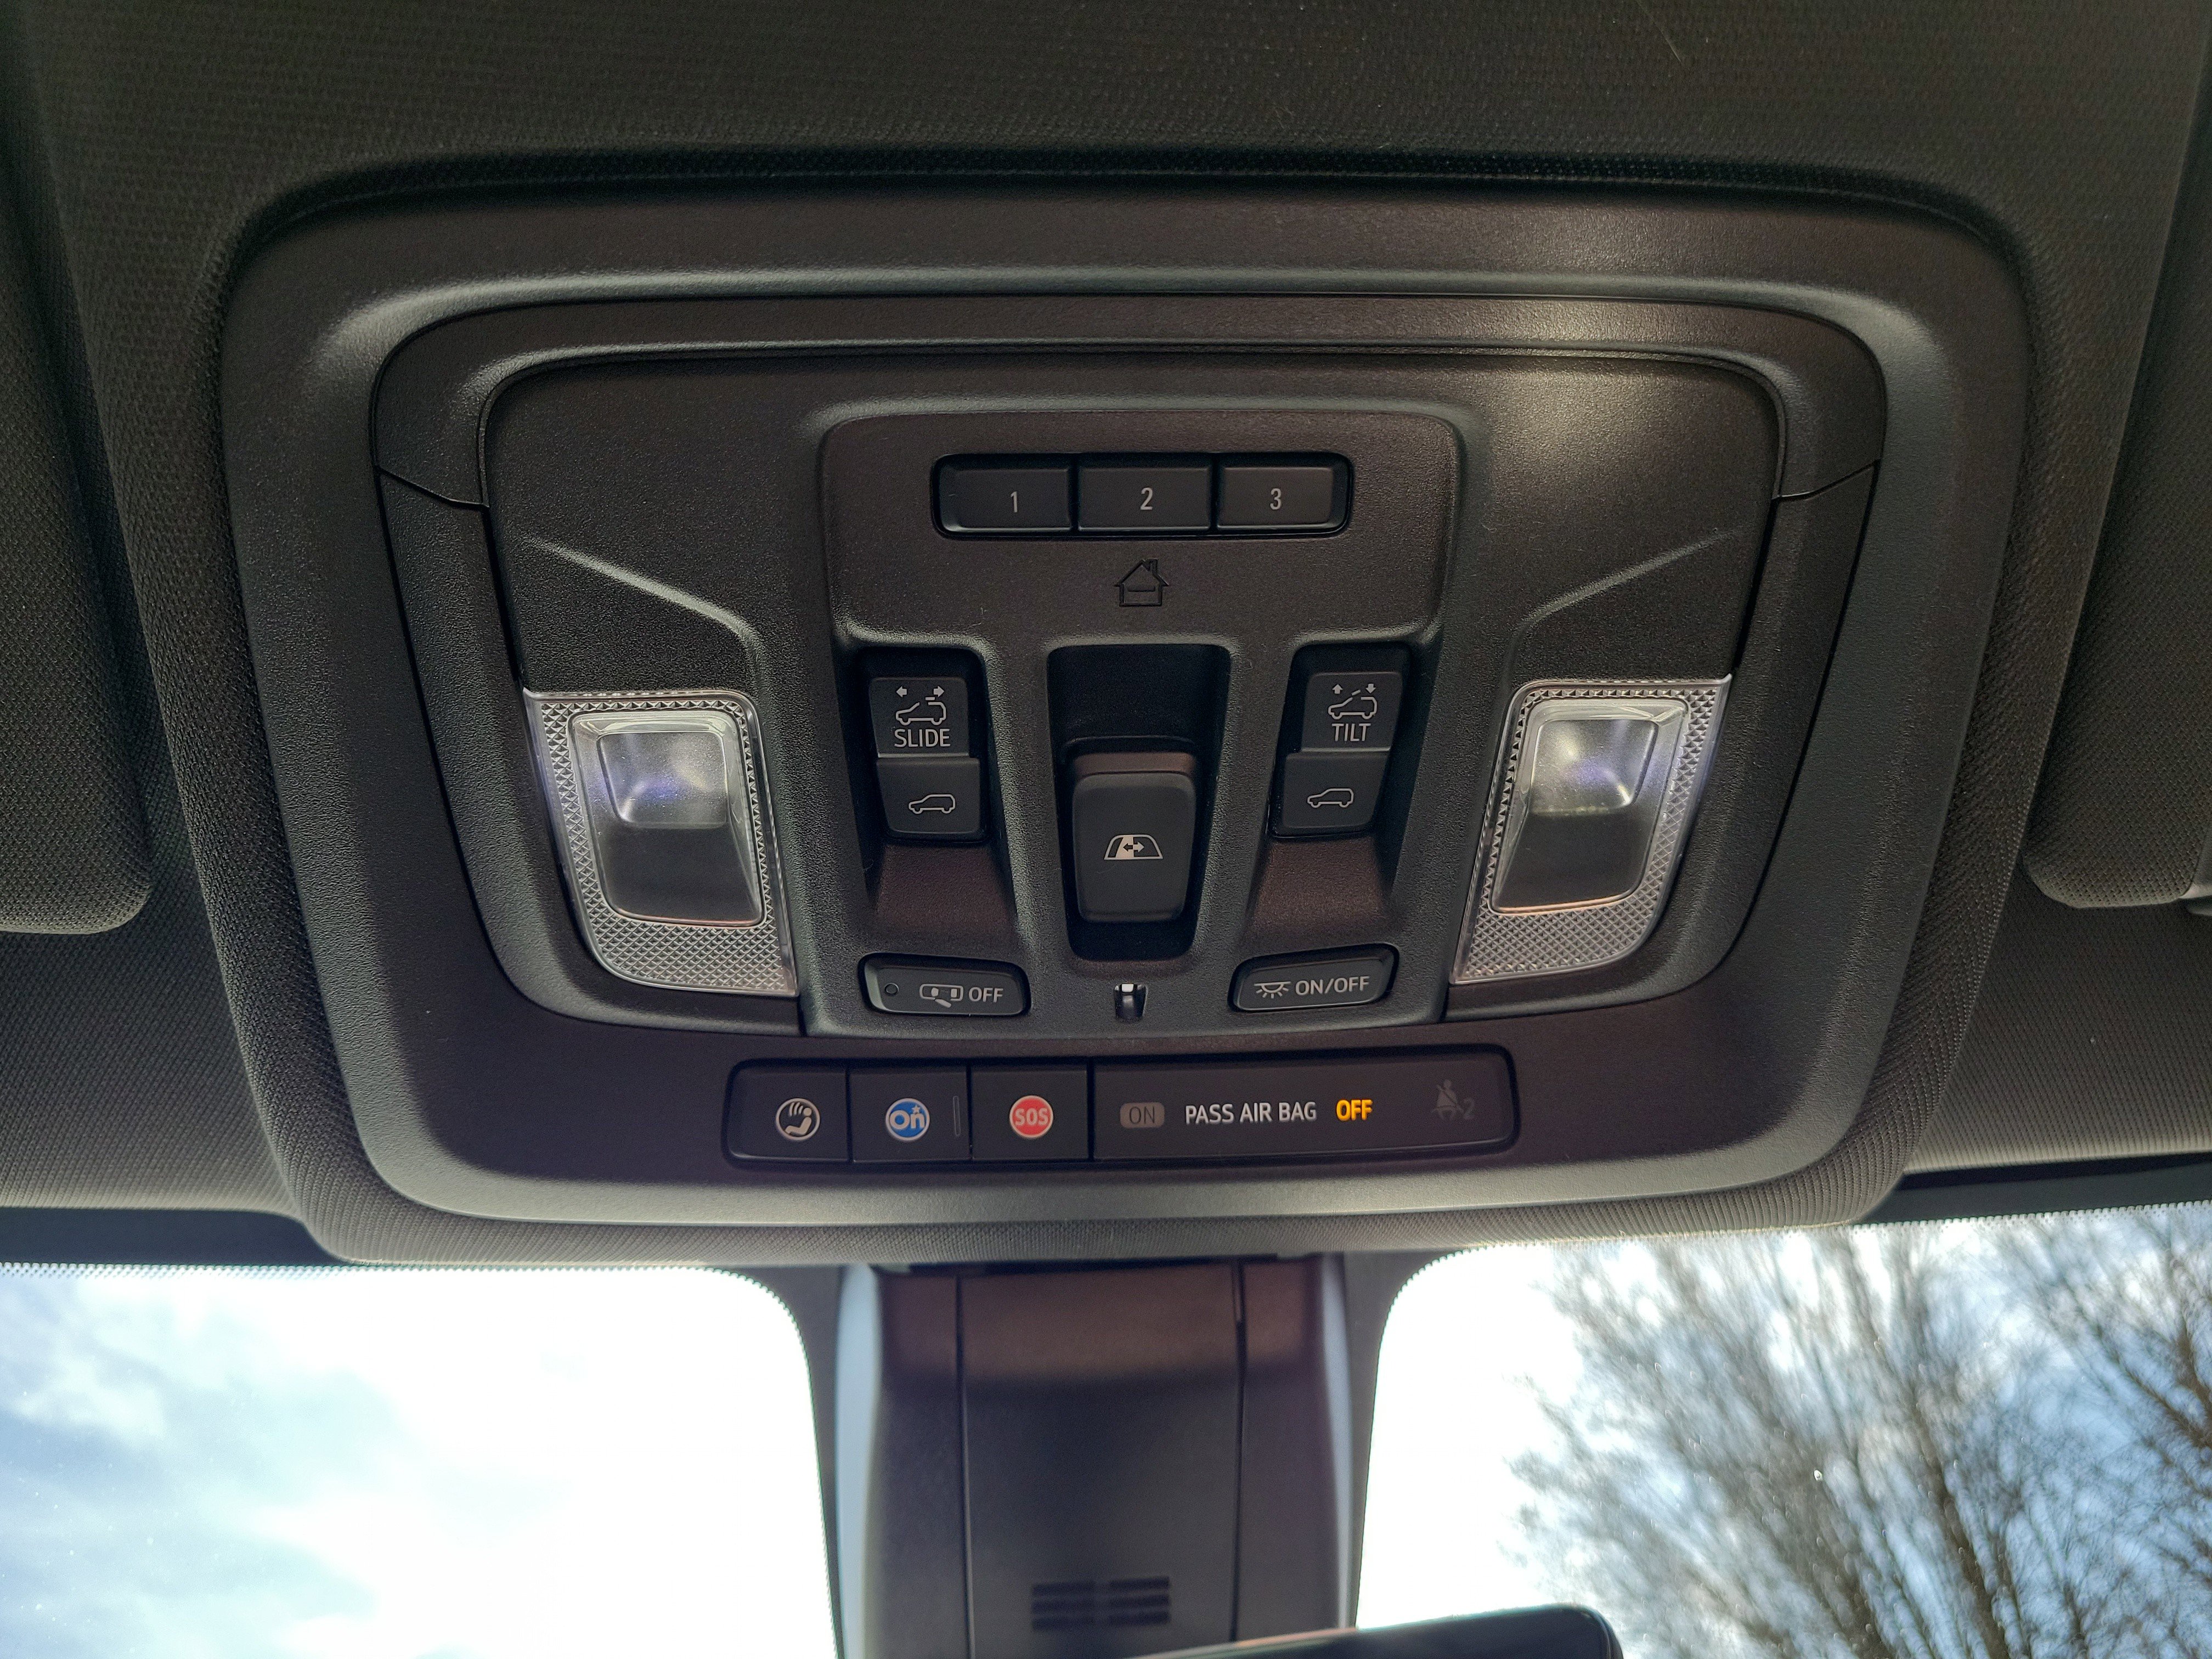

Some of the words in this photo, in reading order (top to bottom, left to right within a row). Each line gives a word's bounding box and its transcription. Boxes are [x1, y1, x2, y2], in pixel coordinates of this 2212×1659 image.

[1010, 492, 1019, 513] 1
[1140, 488, 1153, 511] 2
[1269, 488, 1282, 510] 3
[894, 729, 951, 748] SLIDE
[1331, 723, 1371, 742] TILT
[968, 986, 1004, 1003] OFF
[1295, 976, 1370, 996] ON/OFF
[1014, 1108, 1049, 1126] SOS
[1128, 1105, 1155, 1125] ON
[1185, 1103, 1234, 1125] PASS
[1239, 1102, 1273, 1124] AIR
[1278, 1101, 1317, 1122] BAG
[1336, 1099, 1373, 1122] OFF
[1463, 1099, 1475, 1120] 2
